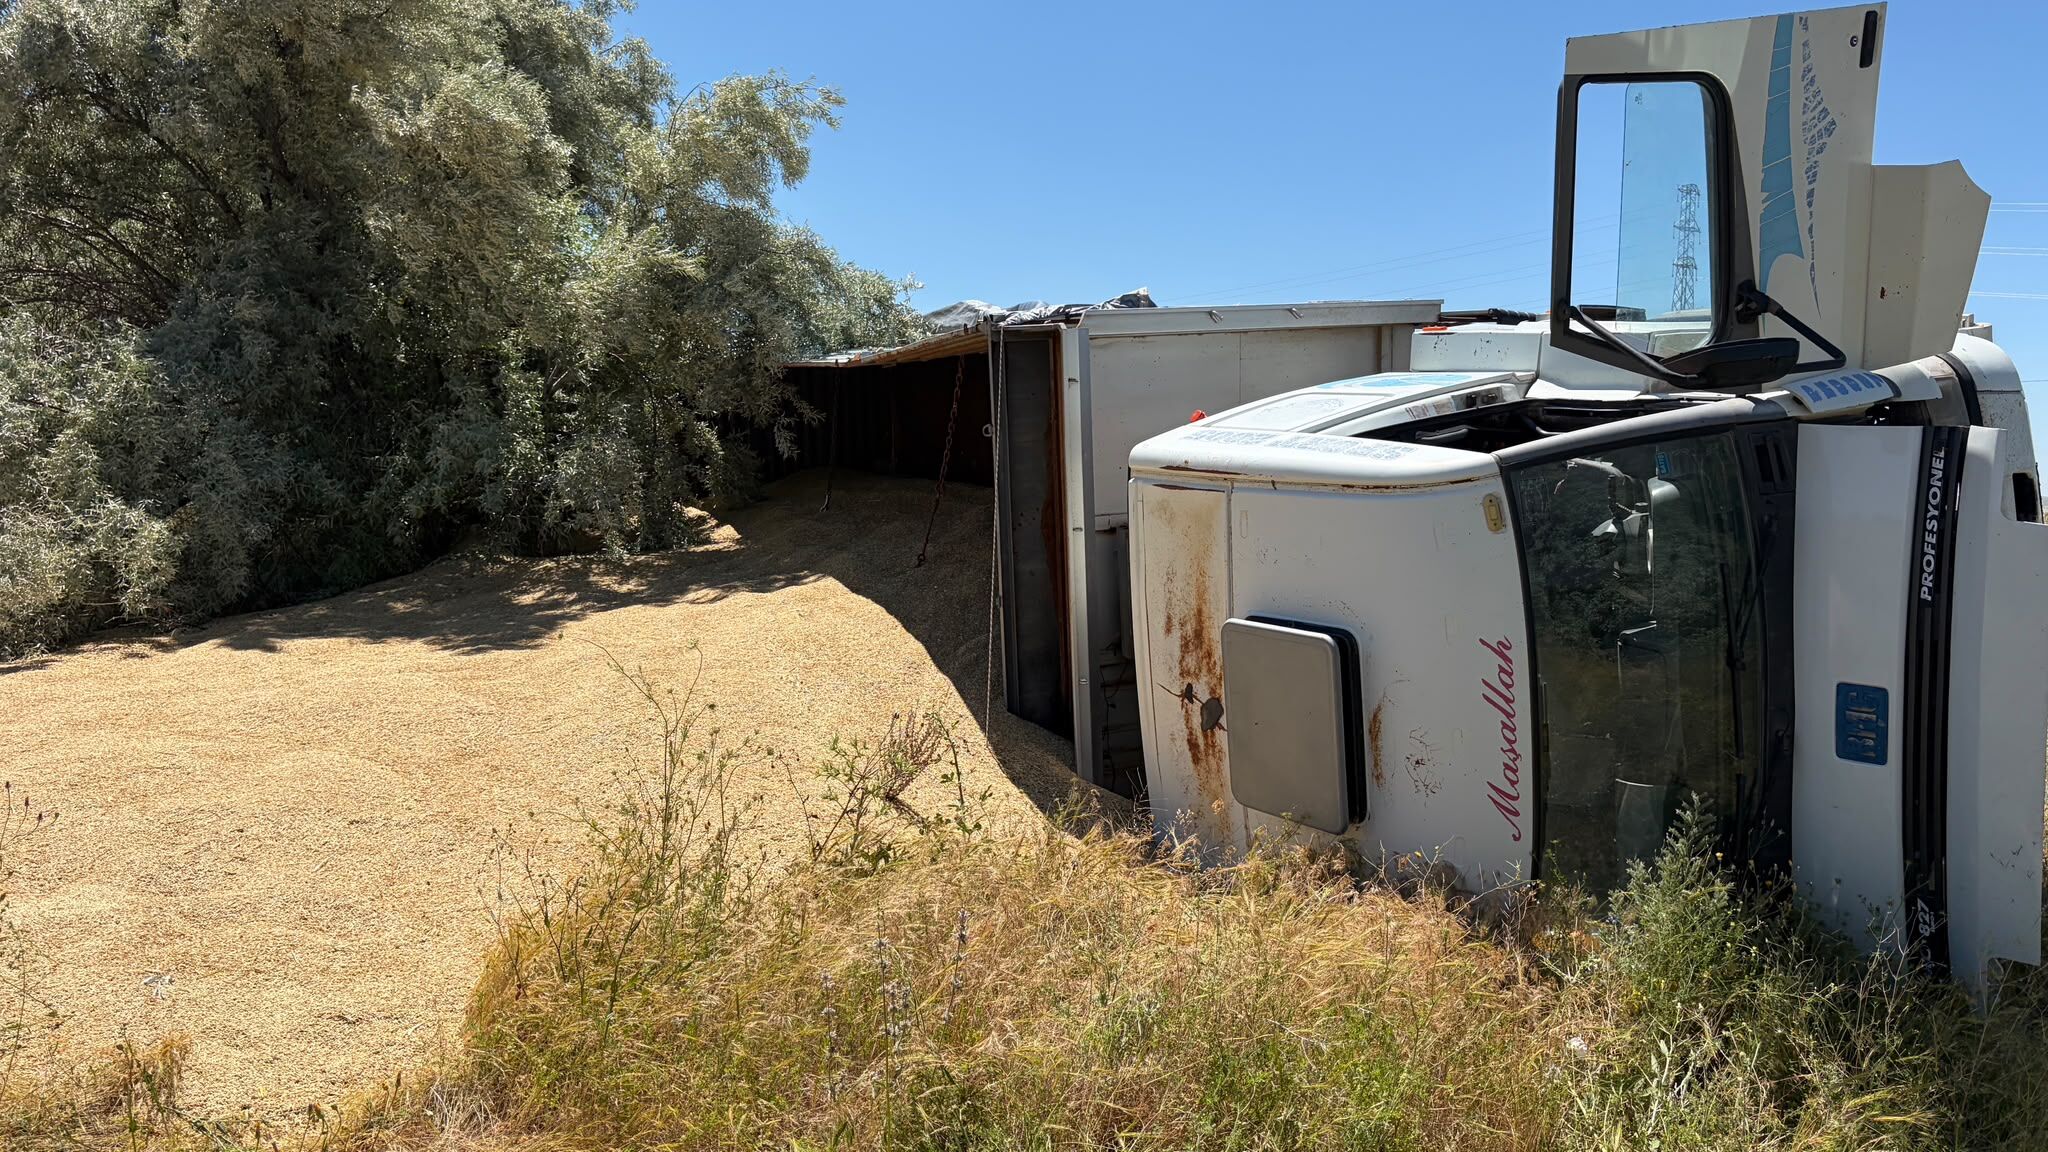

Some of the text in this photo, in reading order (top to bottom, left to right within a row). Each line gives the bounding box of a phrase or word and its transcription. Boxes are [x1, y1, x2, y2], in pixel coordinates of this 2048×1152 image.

[1920, 446, 1945, 602] PROFESYONEL
[1478, 634, 1523, 842] Maşallah
[1917, 897, 1930, 937] 827
